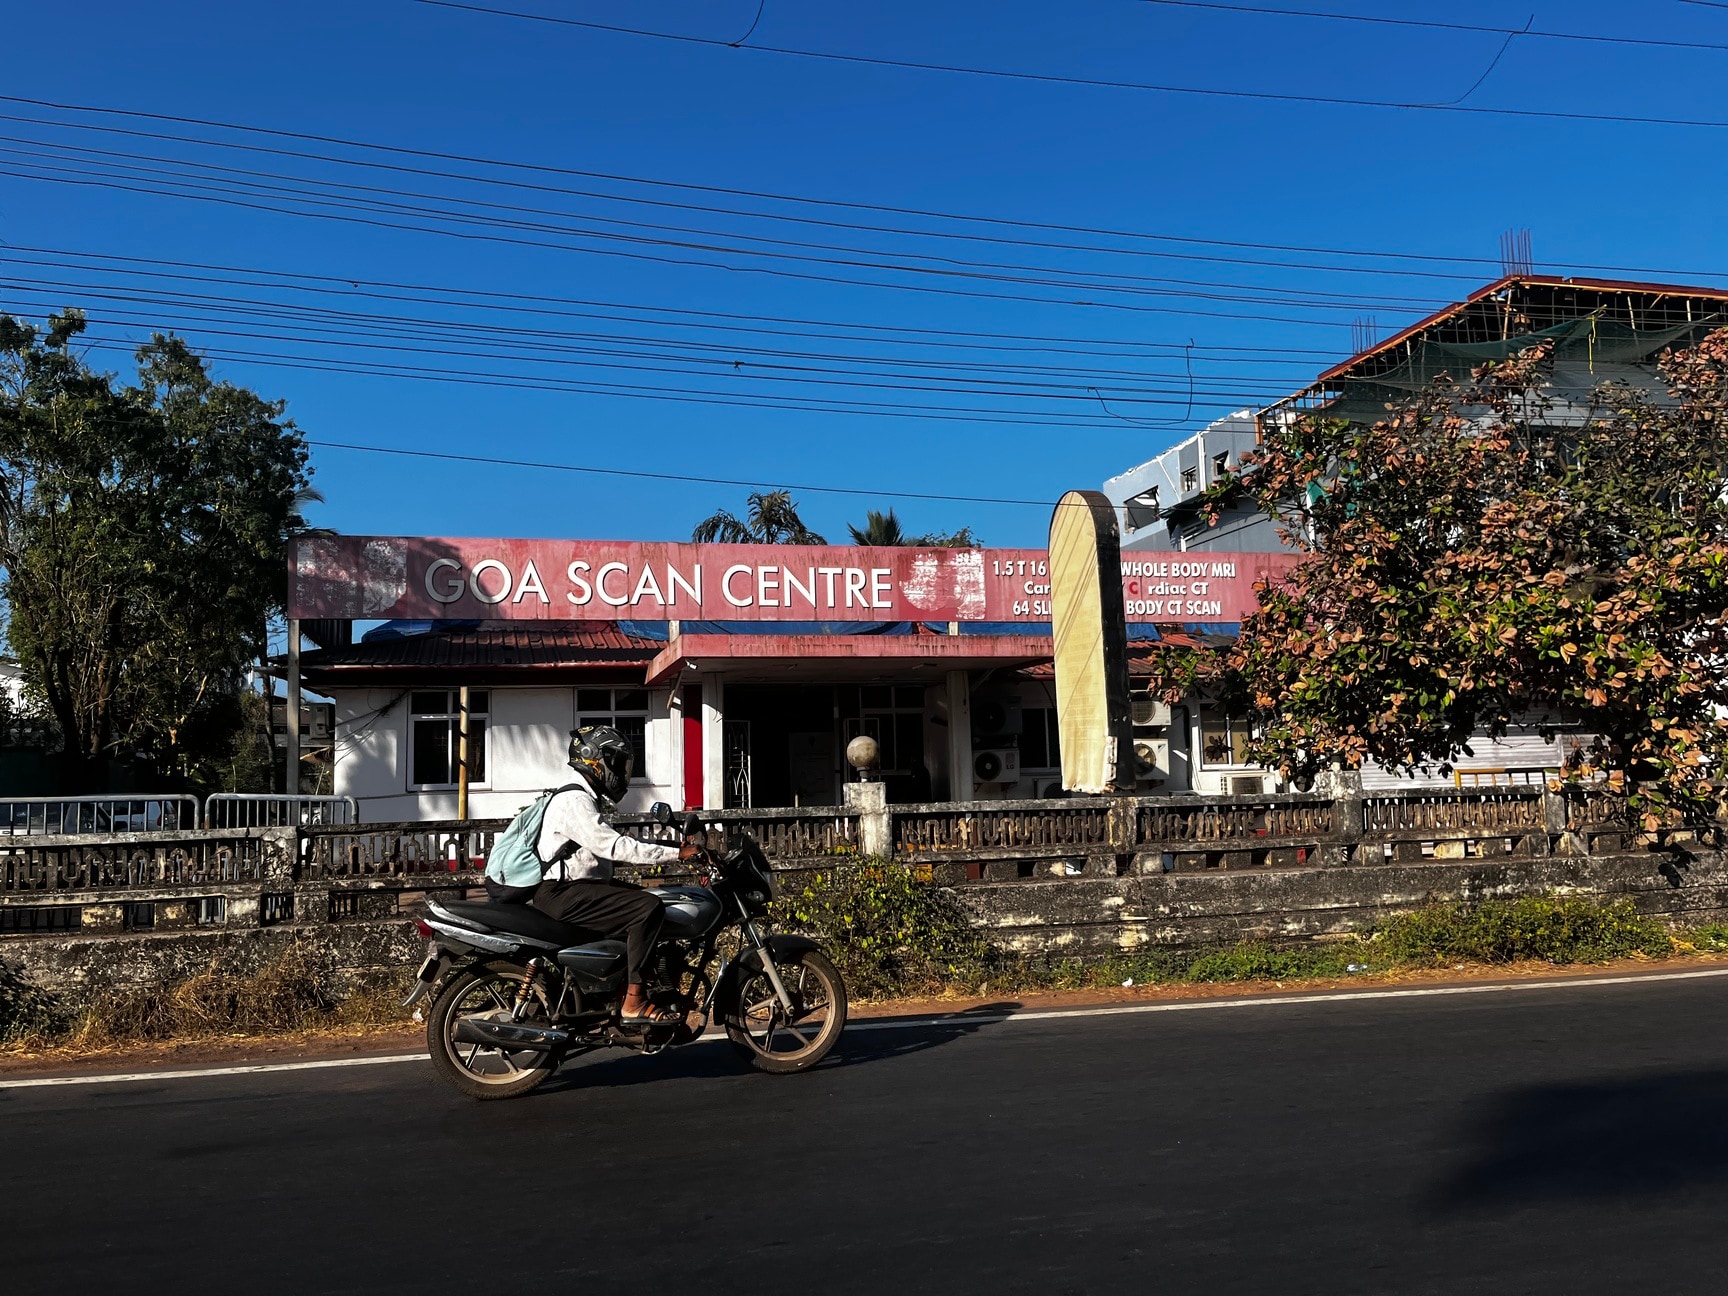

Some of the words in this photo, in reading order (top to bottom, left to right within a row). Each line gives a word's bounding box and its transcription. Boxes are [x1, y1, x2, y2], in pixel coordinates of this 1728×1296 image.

[993, 560, 1014, 577] 1.5
[1017, 560, 1026, 577] T
[1030, 560, 1047, 577] 16
[1121, 561, 1168, 577] WHOLE
[1171, 562, 1209, 577] BODY
[1211, 563, 1236, 578] MRI
[424, 558, 549, 604] GOA
[566, 560, 703, 606] SCAN
[721, 564, 893, 609] CENTRE
[1191, 582, 1209, 595] CT
[1013, 600, 1031, 616] 64
[1126, 601, 1164, 615] BODY
[1167, 601, 1183, 615] CT
[1186, 601, 1222, 616] SCAN
